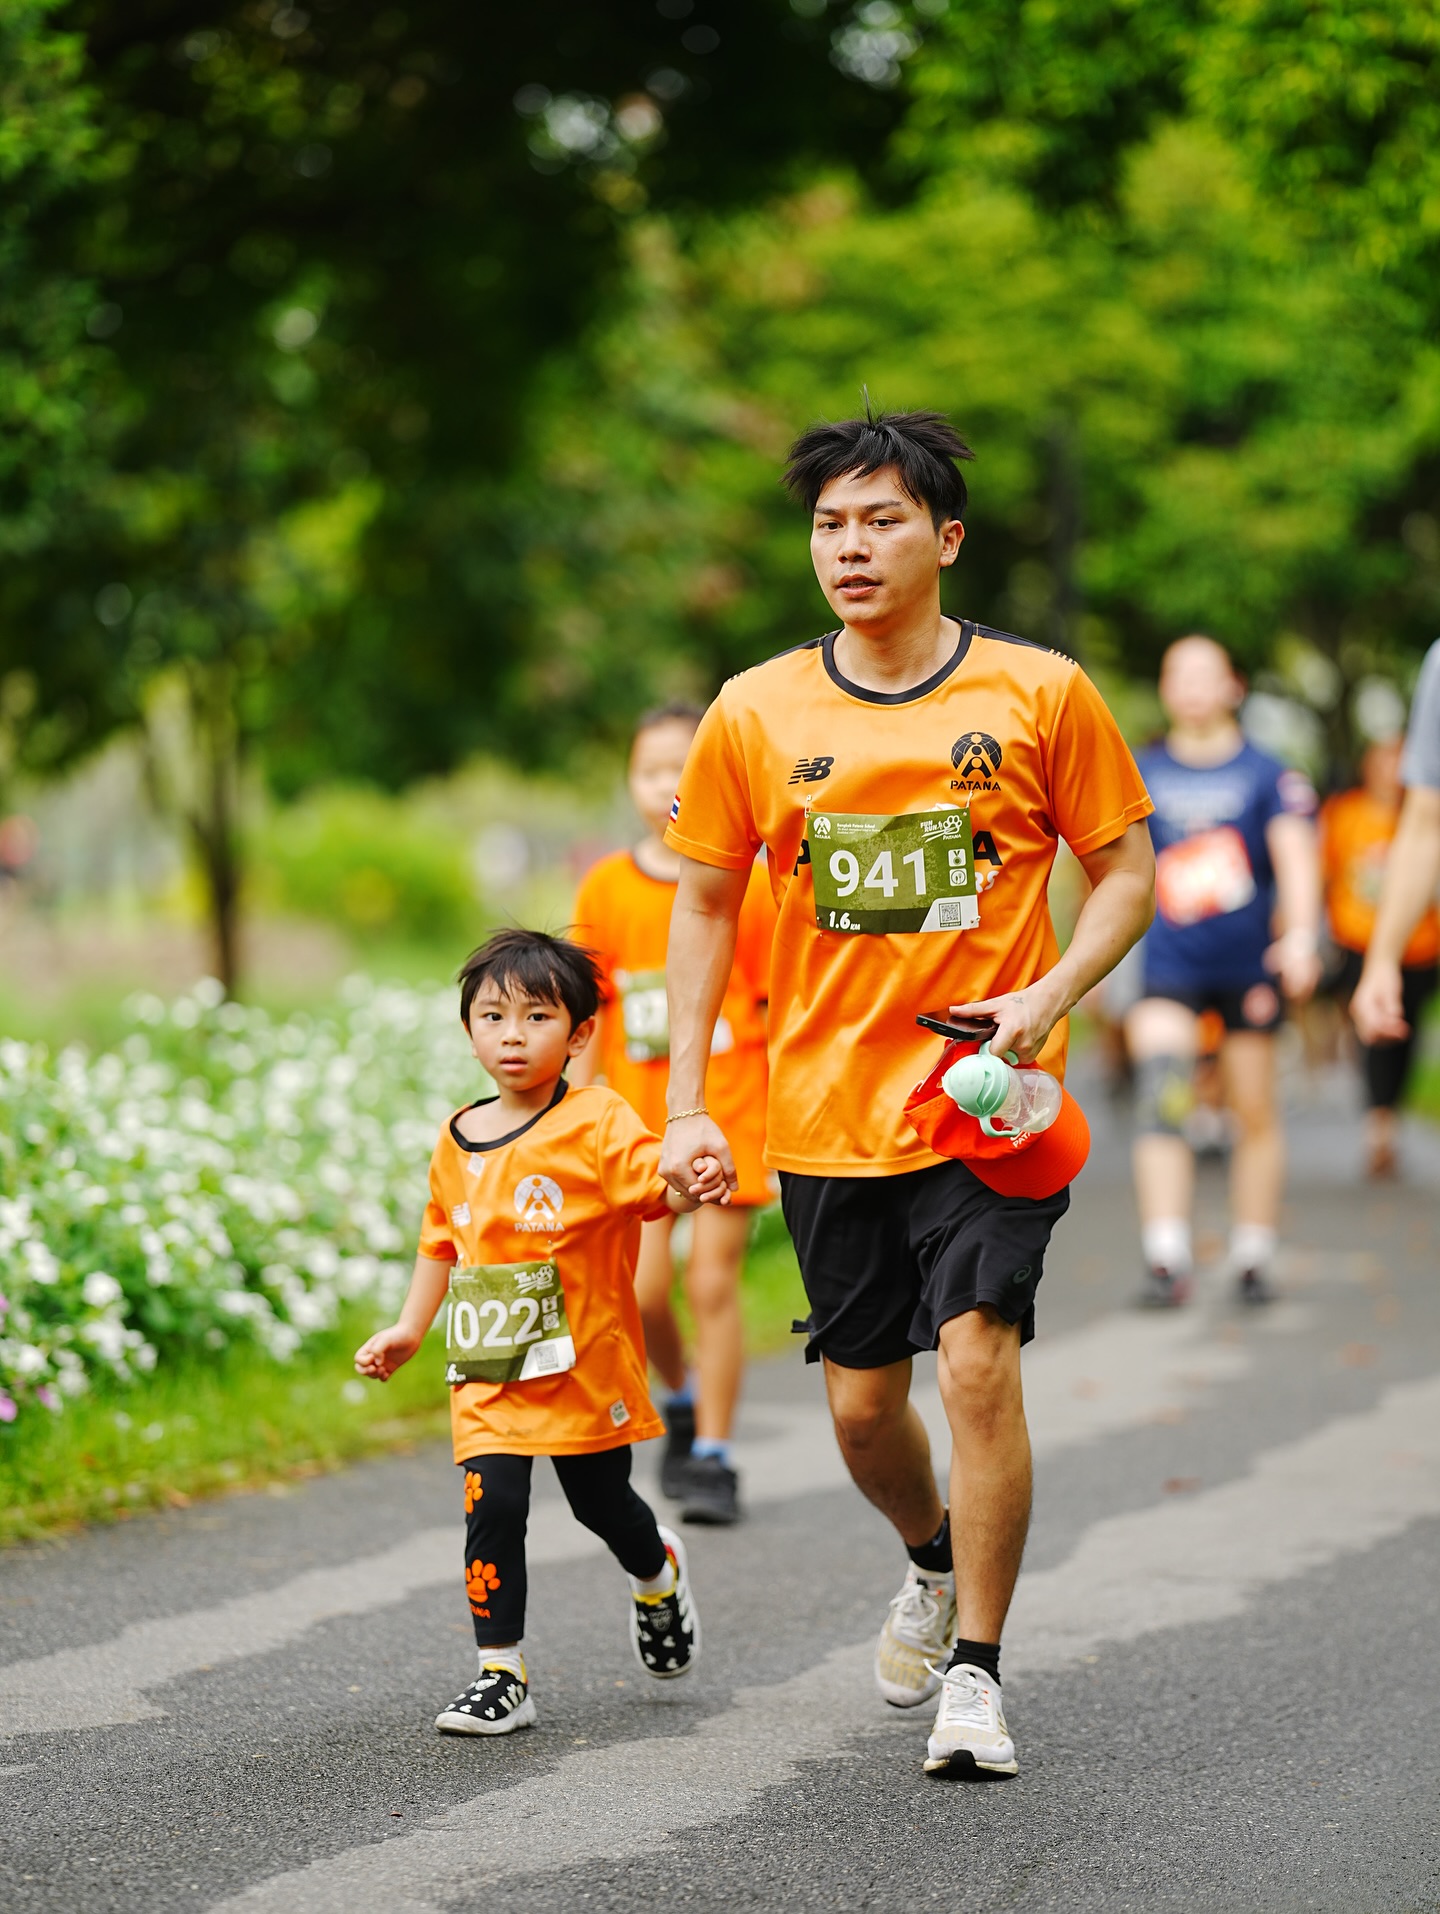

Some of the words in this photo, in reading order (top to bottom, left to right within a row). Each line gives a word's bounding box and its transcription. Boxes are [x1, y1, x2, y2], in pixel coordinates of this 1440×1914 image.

[950, 780, 1002, 791] PATANA
[829, 848, 926, 898] 941
[515, 1221, 565, 1233] PATANA
